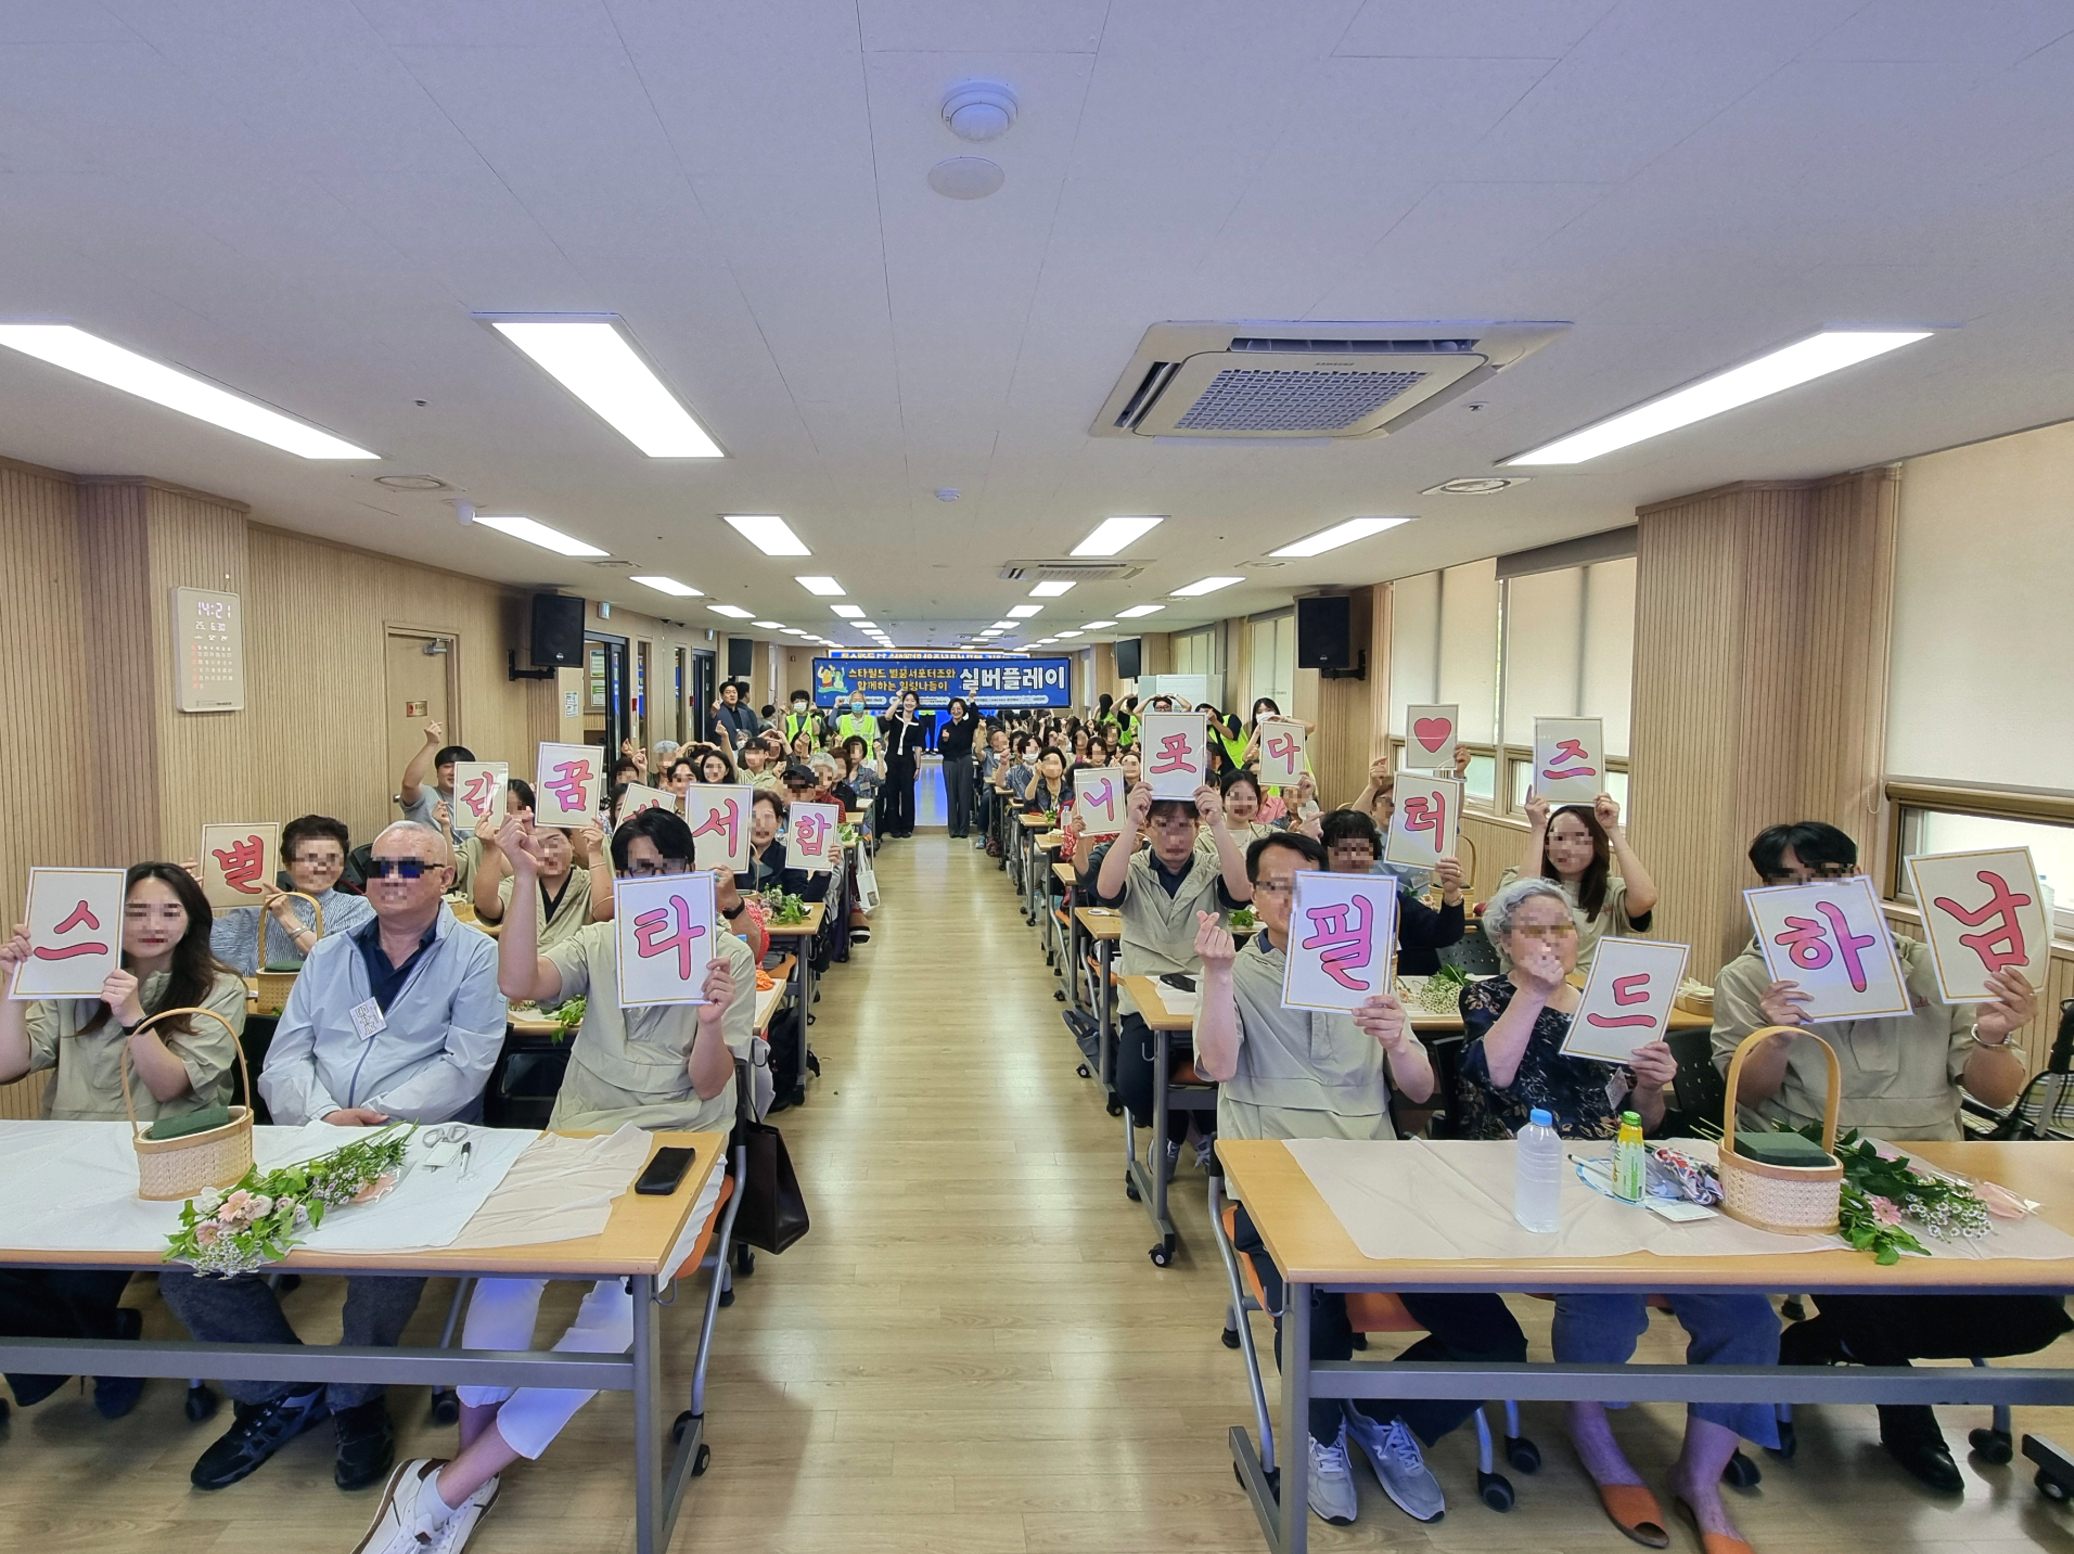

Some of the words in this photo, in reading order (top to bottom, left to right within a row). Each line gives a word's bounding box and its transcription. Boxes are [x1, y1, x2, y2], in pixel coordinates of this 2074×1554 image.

[197, 601, 231, 619] 14:21
[960, 666, 1065, 691] 실버플레이
[1150, 732, 1198, 775] 포
[1267, 732, 1301, 774] 다
[1542, 738, 1597, 781] 즈
[460, 771, 494, 817] 감
[543, 758, 595, 813] 꿈
[1082, 777, 1115, 821] 니
[692, 797, 740, 858] 서
[795, 812, 832, 856] 합
[1404, 790, 1447, 853] 터
[211, 834, 265, 894] 별
[32, 900, 109, 961] 스
[633, 894, 706, 981] 타
[1302, 894, 1375, 991] 필
[1774, 900, 1876, 993] 하
[1934, 870, 2033, 973] 남
[1586, 973, 1657, 1029] 드
